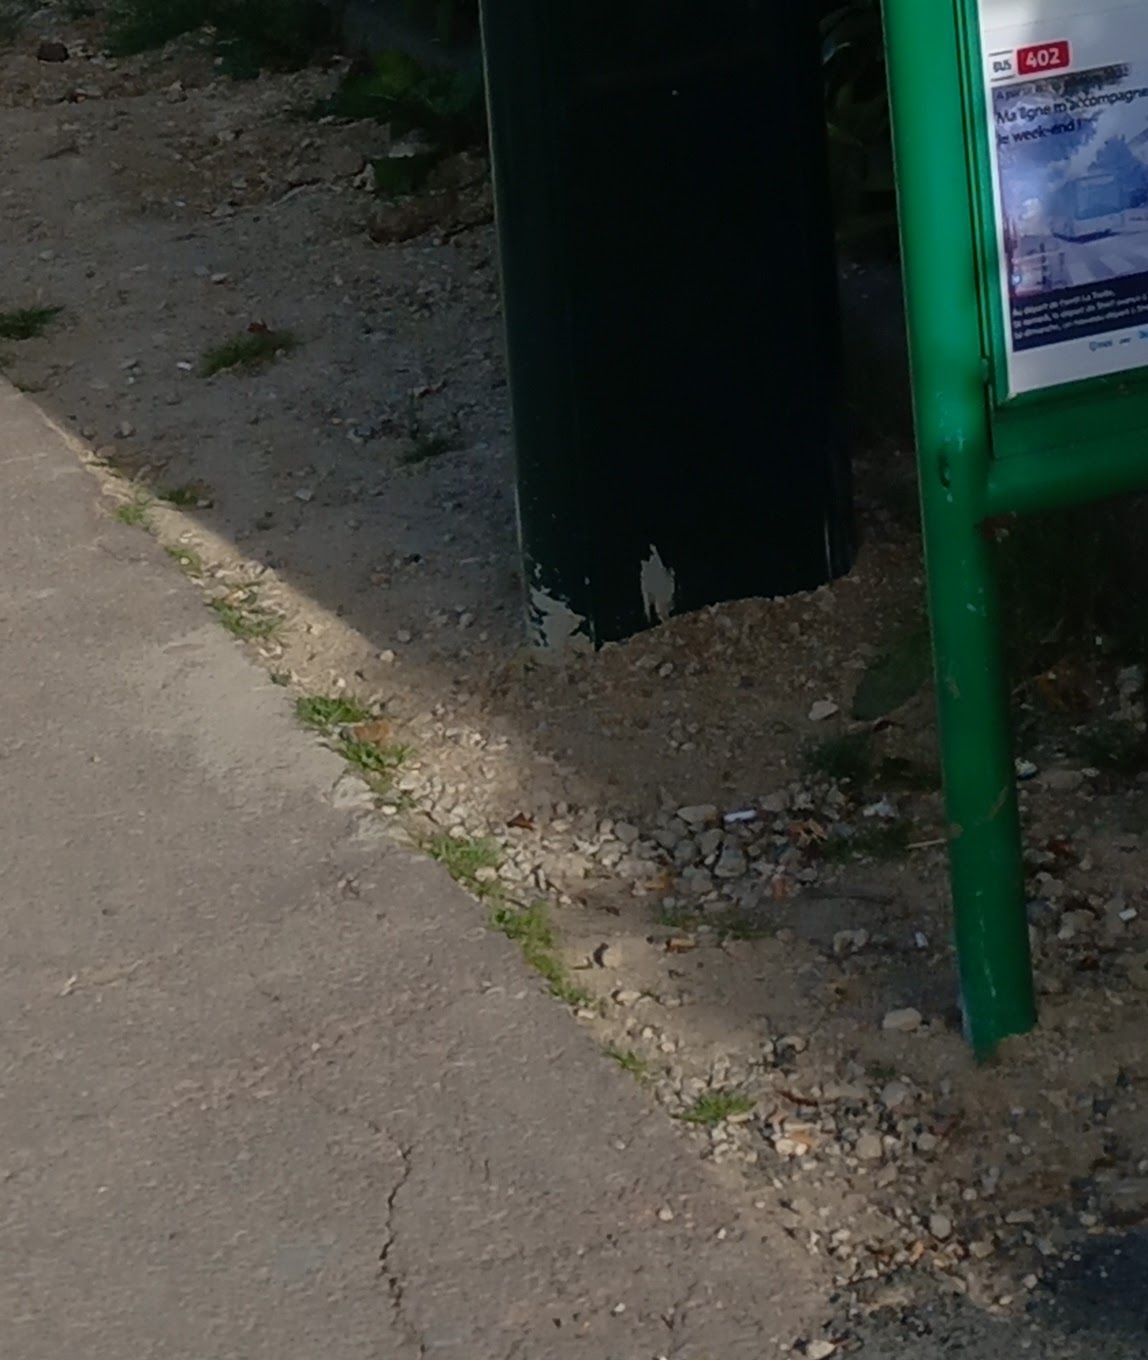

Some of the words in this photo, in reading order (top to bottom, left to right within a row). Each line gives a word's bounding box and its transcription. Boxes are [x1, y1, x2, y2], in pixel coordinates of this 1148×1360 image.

[993, 59, 1012, 73] BUS
[1025, 47, 1061, 67] 402
[1019, 103, 1051, 120] ligne
